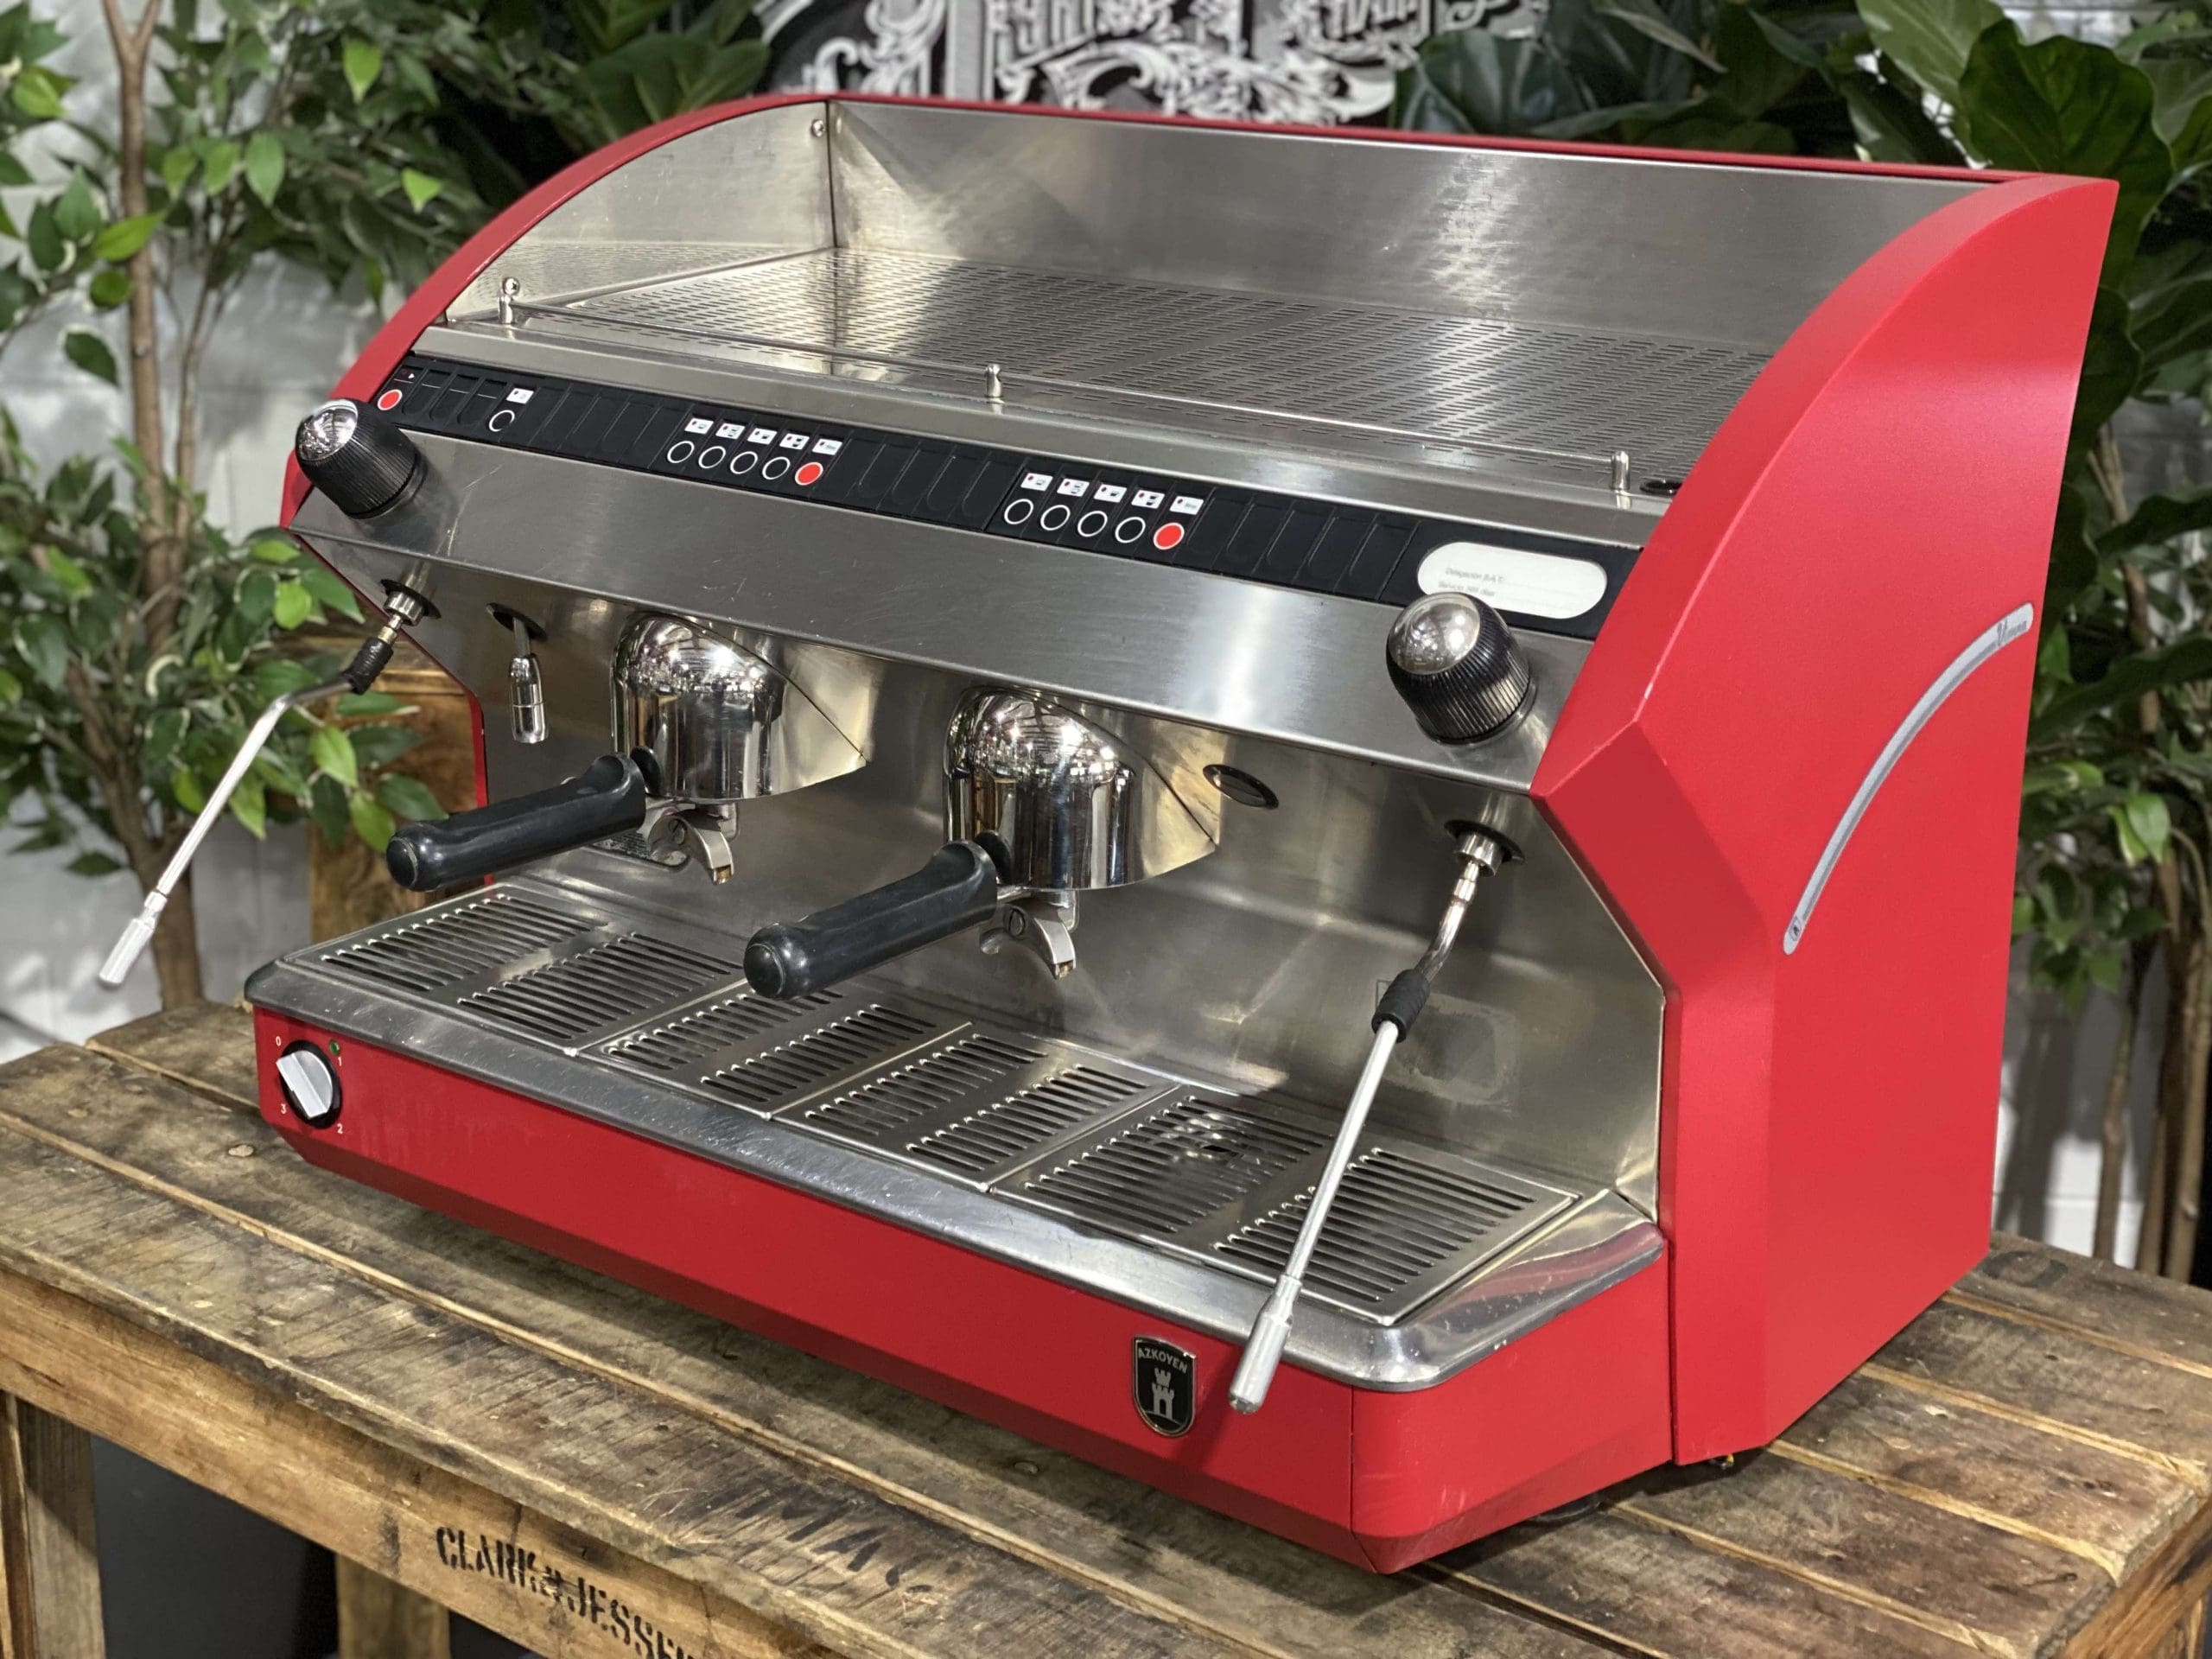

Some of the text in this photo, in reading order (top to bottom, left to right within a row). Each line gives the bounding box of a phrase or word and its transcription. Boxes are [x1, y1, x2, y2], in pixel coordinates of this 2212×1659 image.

[275, 1036, 282, 1046] 0
[338, 1056, 342, 1067] 1
[281, 1104, 287, 1115] 3
[337, 1123, 344, 1135] 2
[1137, 1347, 1188, 1375] AZKOYEN
[567, 1575, 698, 1659] JESSE
